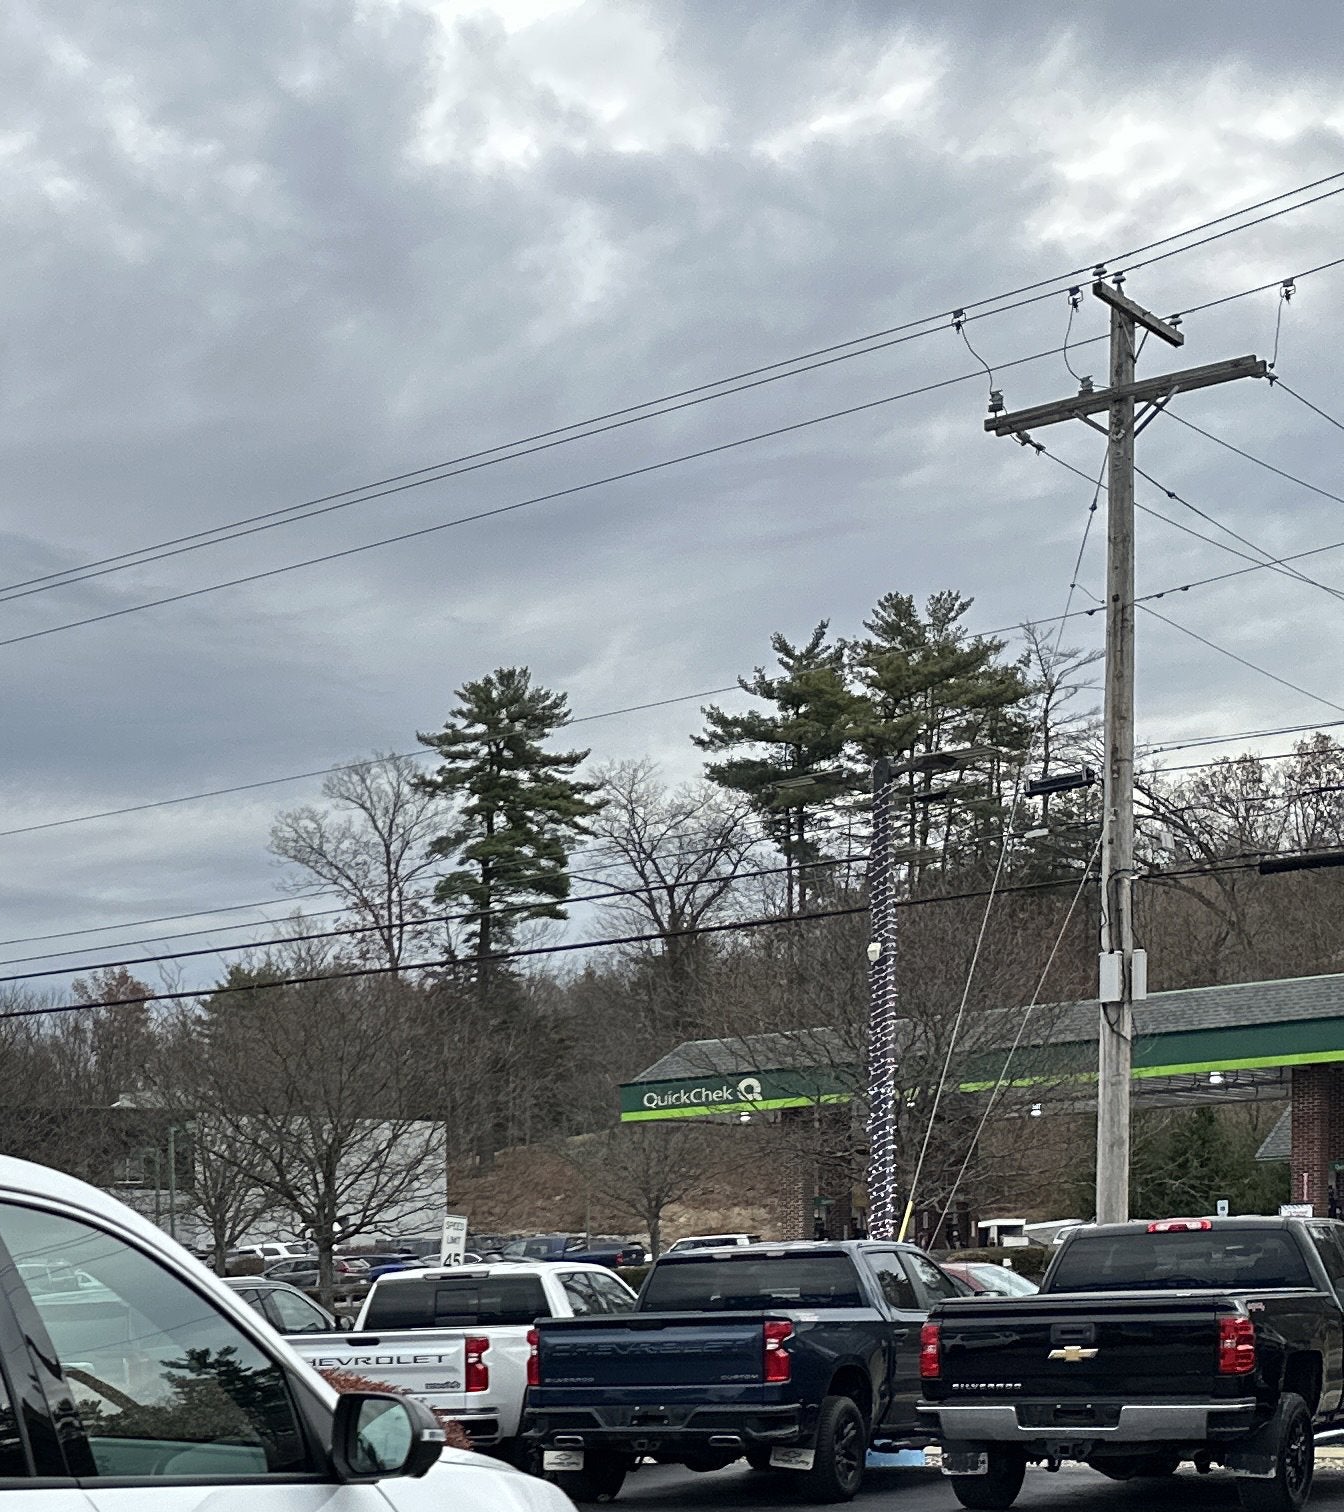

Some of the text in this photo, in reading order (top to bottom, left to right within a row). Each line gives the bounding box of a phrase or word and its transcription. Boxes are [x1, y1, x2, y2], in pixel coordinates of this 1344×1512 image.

[643, 1085, 734, 1109] QuickChek
[443, 1252, 461, 1267] 45
[305, 1354, 448, 1367] HEVROLET
[952, 1383, 1023, 1391] SILVERADO
